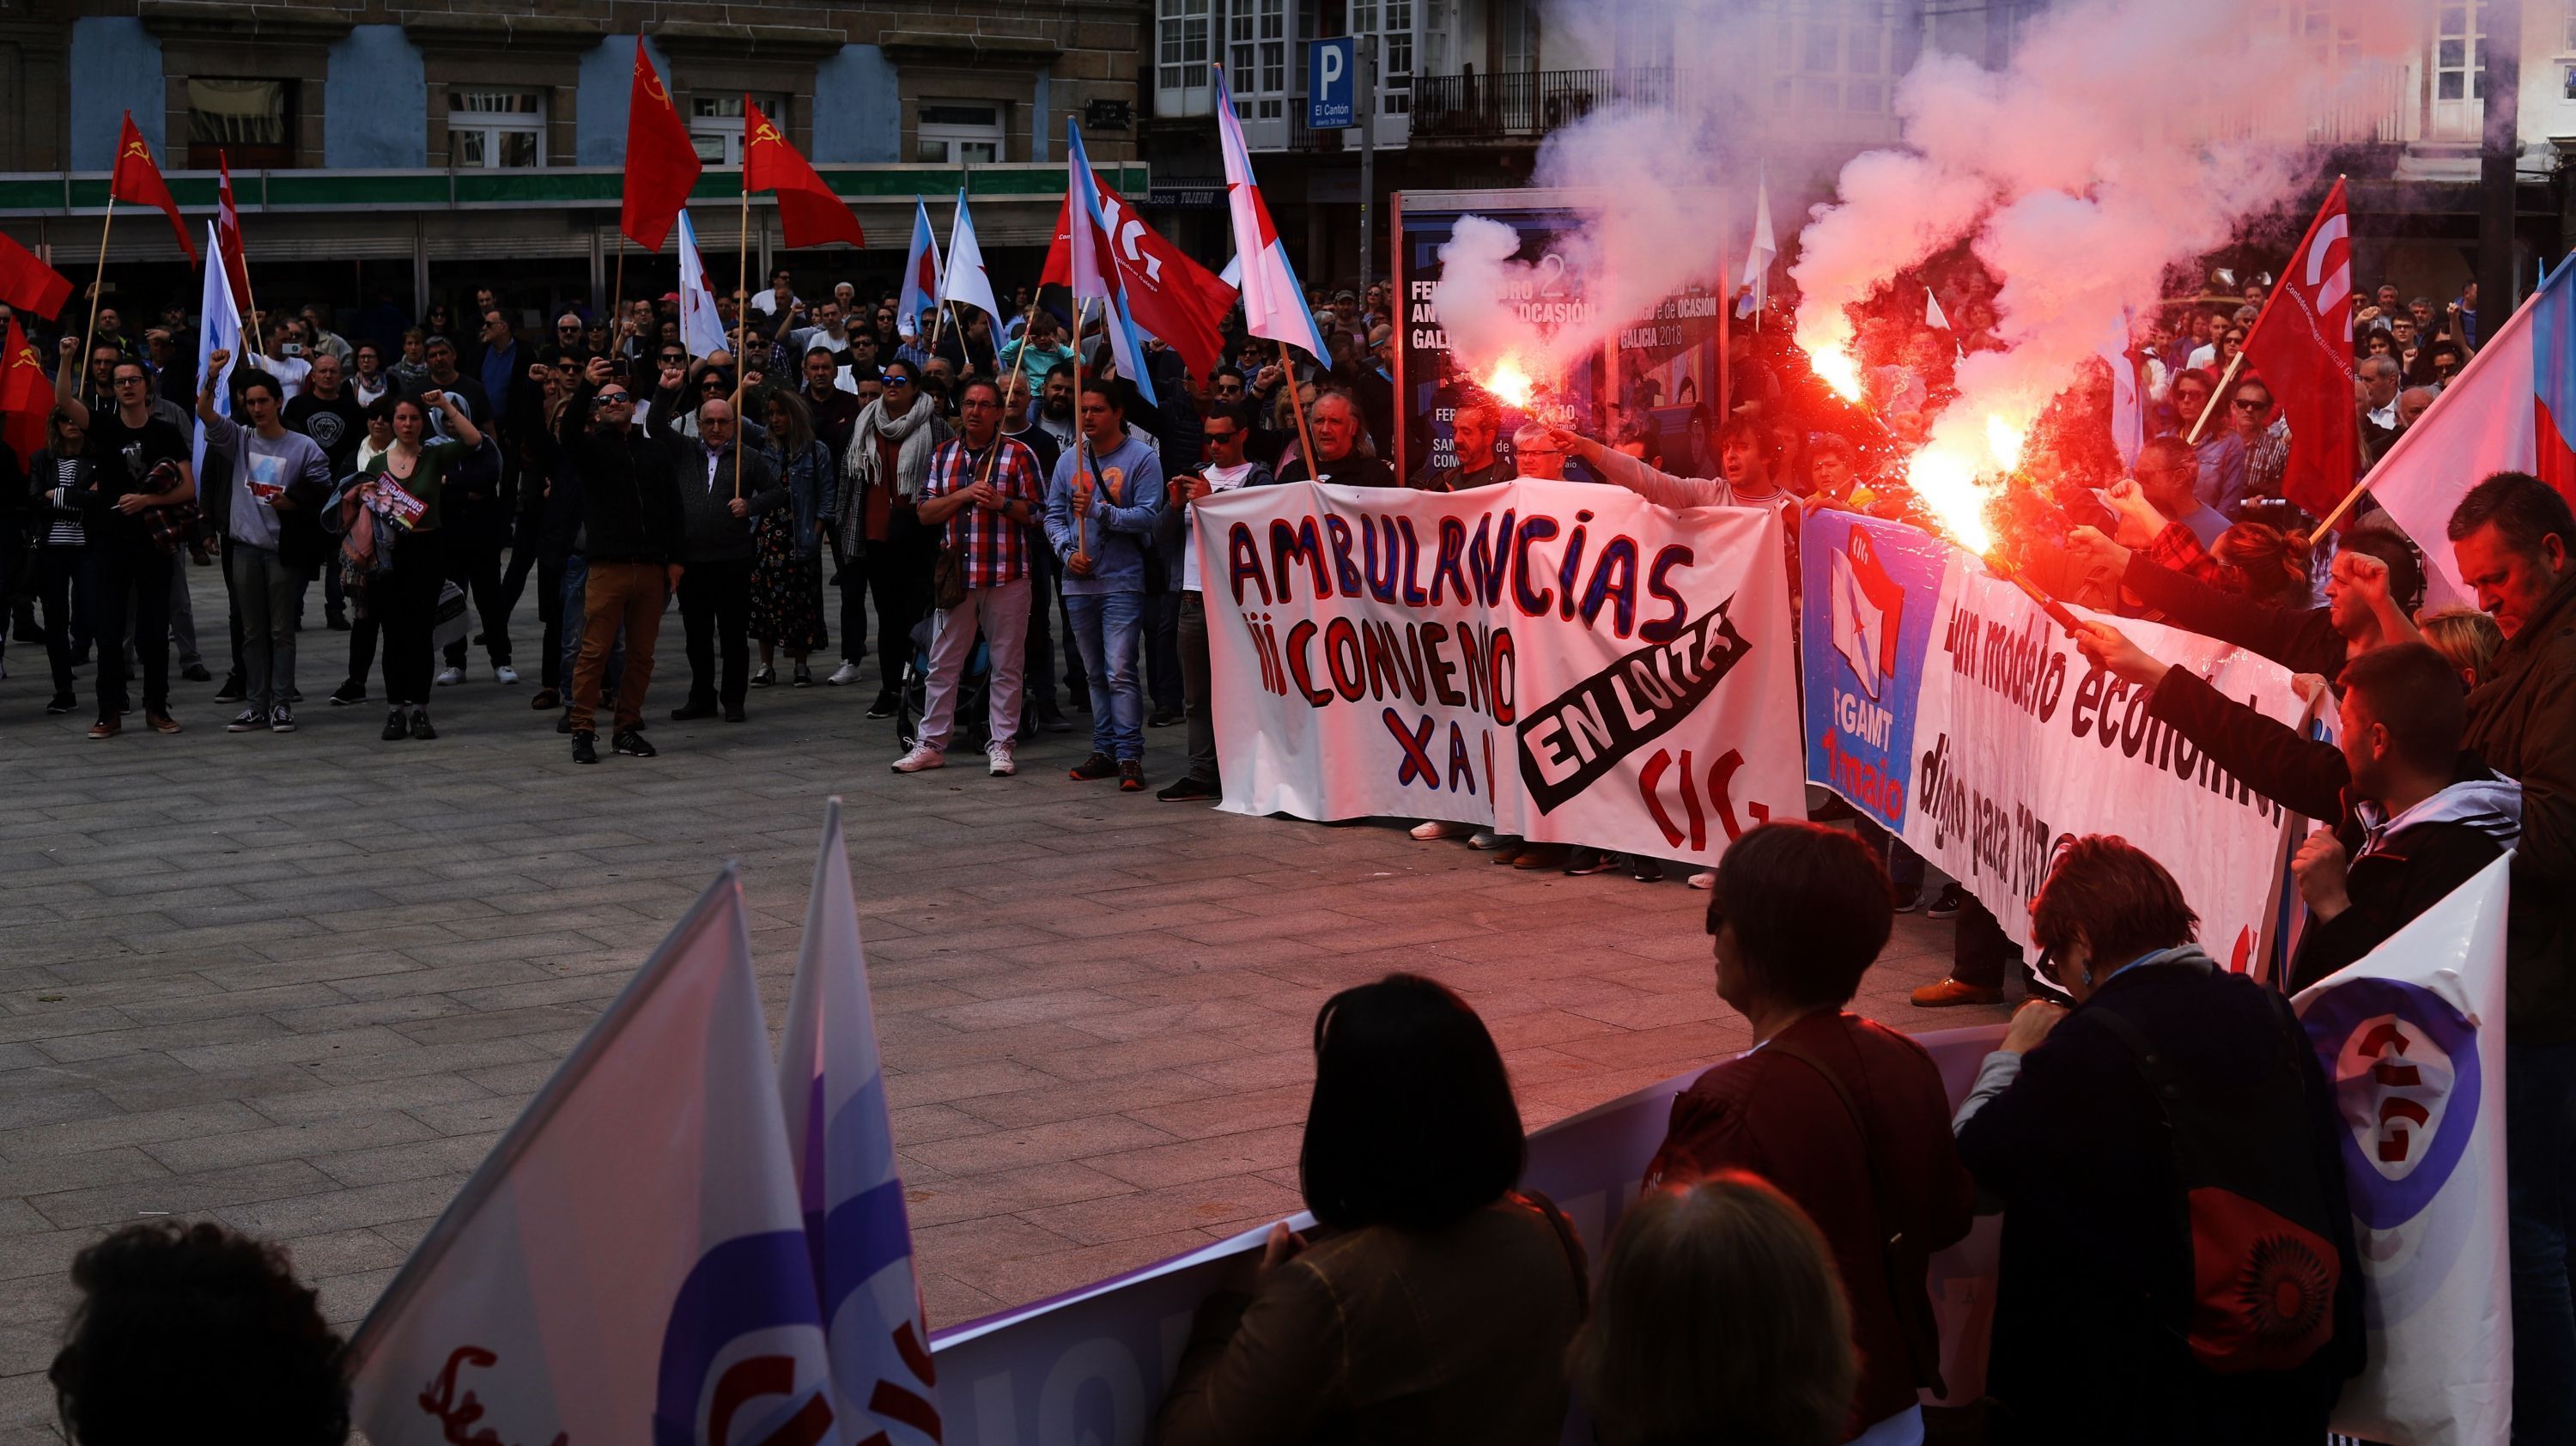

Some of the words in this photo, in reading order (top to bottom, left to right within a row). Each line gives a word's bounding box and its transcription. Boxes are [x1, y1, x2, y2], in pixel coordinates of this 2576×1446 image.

[1321, 45, 1343, 100] P
[1315, 105, 1322, 116] El
[1324, 103, 1349, 115] Cantón
[1180, 191, 1215, 204] TOJEIRO
[1519, 299, 1596, 323] OCASIÓN
[1664, 300, 1674, 319] de
[1677, 294, 1716, 319] OCASIÓN
[1620, 327, 1657, 349] GALICIA
[1659, 325, 1682, 346] 2018
[1497, 440, 1509, 452] de
[1853, 535, 1868, 565] CIG
[1953, 608, 1979, 680] un
[1982, 612, 2066, 724] modelo
[1524, 690, 1613, 787] EN
[1611, 612, 1732, 732] LOITA
[1638, 748, 1770, 851] CIG
[1838, 750, 1903, 822] maio
[1972, 787, 2010, 884] para
[2358, 1023, 2430, 1162] CIG
